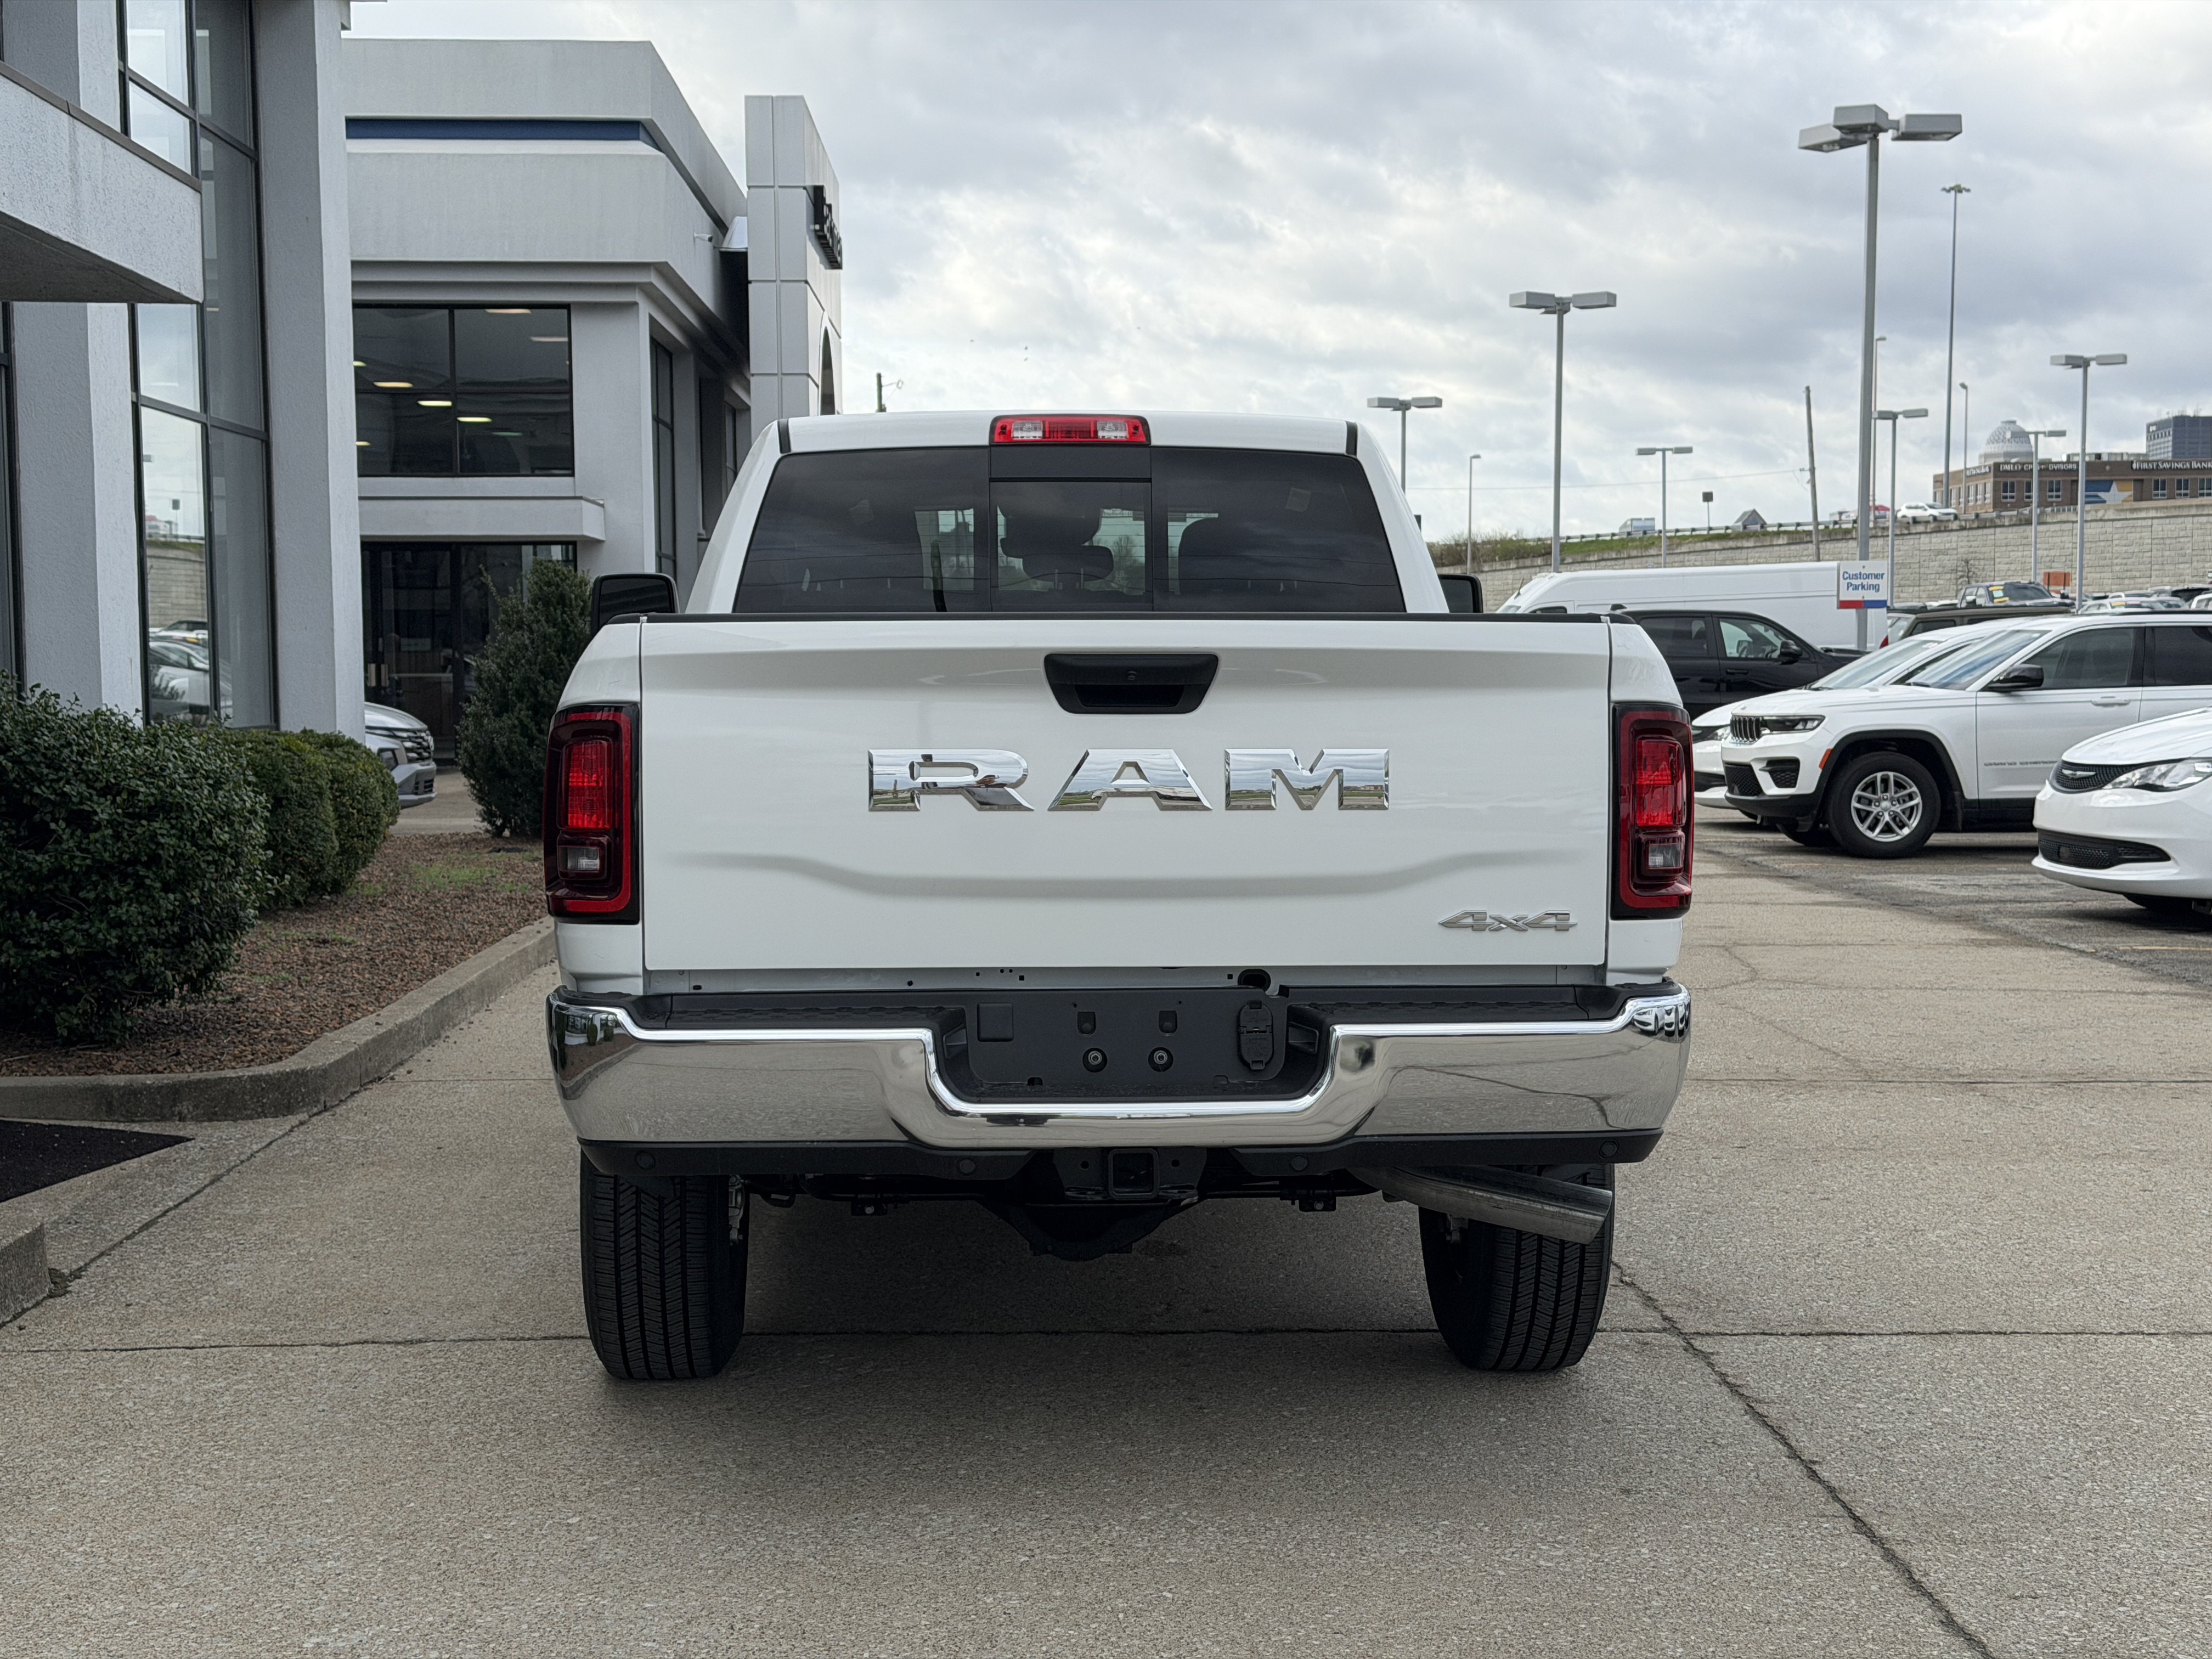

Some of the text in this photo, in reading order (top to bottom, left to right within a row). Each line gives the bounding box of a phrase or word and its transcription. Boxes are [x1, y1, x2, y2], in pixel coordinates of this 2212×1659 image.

[2136, 461, 2157, 470] FIRST
[2158, 461, 2191, 470] SAVINGS
[1842, 571, 1885, 580] Customer
[1847, 582, 1880, 592] Parking
[868, 748, 1390, 811] RAM
[1438, 910, 1578, 931] 4x4
